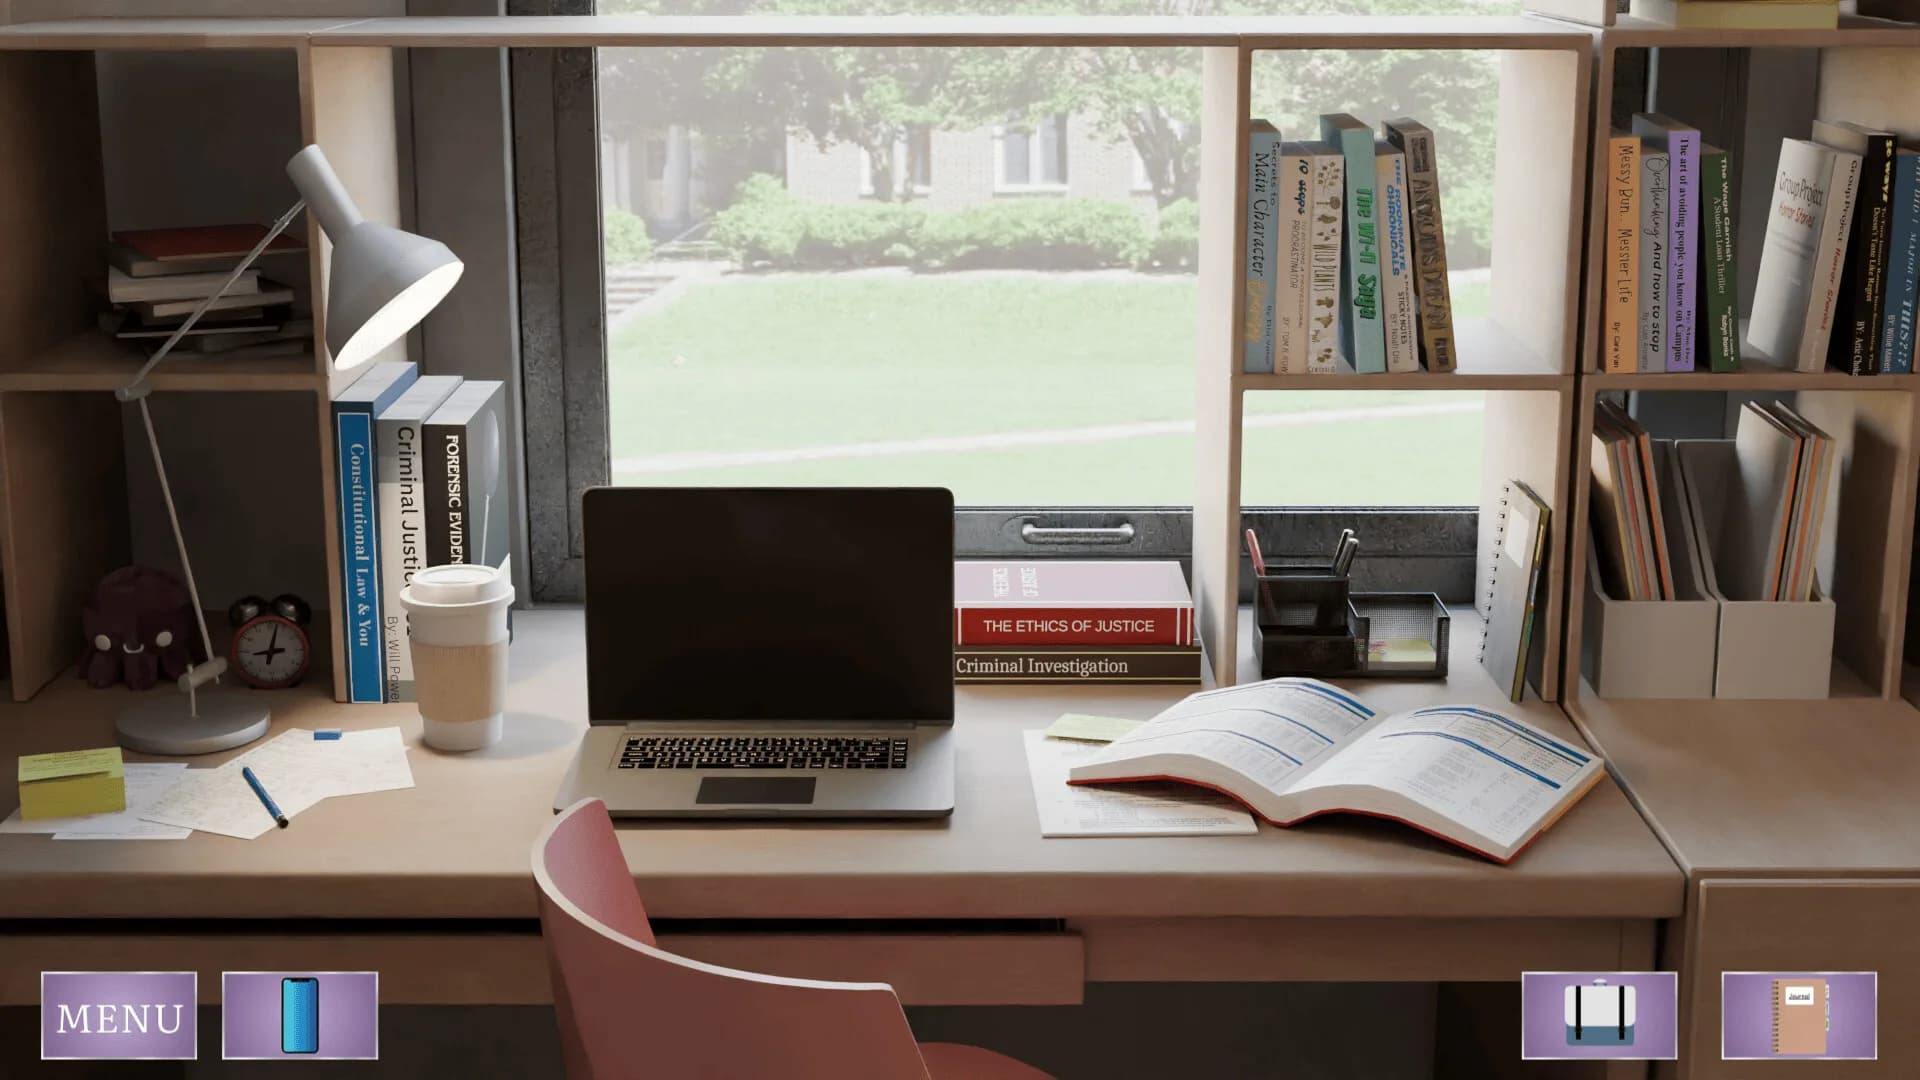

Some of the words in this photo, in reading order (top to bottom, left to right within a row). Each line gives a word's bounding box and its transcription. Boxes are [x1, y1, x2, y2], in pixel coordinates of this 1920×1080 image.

[1679, 137, 1689, 157] The
[1254, 153, 1271, 193] Main
[1271, 142, 1280, 188] Secrets
[1298, 159, 1310, 175] 10
[1616, 145, 1634, 185] Messy
[1679, 158, 1688, 173] art
[1720, 157, 1728, 179] The
[1845, 160, 1858, 199] Group
[1679, 175, 1688, 186] of
[1779, 171, 1801, 202] Group
[1799, 178, 1824, 207] Project
[1881, 161, 1892, 203] ways
[1270, 192, 1279, 206] to
[1293, 180, 1308, 216] steps
[1356, 187, 1374, 218] The
[1675, 187, 1688, 228] avoiding
[1711, 197, 1721, 205] A
[1721, 182, 1730, 214] Wage
[1912, 188, 1920, 213] DID
[1387, 185, 1401, 276] CHRONICALS
[1395, 189, 1407, 271] ROOMMATE
[1713, 205, 1723, 238] Student
[1837, 200, 1851, 242] Project
[1871, 207, 1881, 236] Doesn't
[1252, 199, 1271, 277] Character
[1312, 244, 1339, 262] WILD
[1618, 228, 1633, 275] Messier
[1674, 230, 1687, 261] people
[1715, 240, 1724, 261] Loan
[1723, 217, 1733, 262] Garnish
[1907, 231, 1917, 274] MAJOR
[1289, 219, 1301, 289] PROCRASTINATOR
[1652, 241, 1663, 270] And
[1829, 248, 1842, 284] Horror
[1867, 260, 1877, 277] Like
[1311, 265, 1338, 291] PLANTS
[1673, 263, 1685, 280] you
[1716, 263, 1726, 295] Thriller
[1904, 278, 1913, 292] IN
[1353, 273, 1377, 320] Saga
[1617, 279, 1632, 304] Life
[1652, 273, 1662, 301] how
[1676, 282, 1686, 307] know
[1864, 277, 1875, 302] Regret
[1398, 291, 1406, 317] STICKY
[1651, 305, 1661, 319] to
[1675, 310, 1683, 322] on
[1399, 319, 1408, 345] NOTES
[1649, 323, 1661, 353] stop
[1672, 324, 1684, 362] Campus
[397, 426, 419, 514] Criminal
[445, 434, 462, 508] FORENSIC
[349, 443, 370, 562] Constitutional
[402, 520, 419, 588] Justic
[355, 568, 370, 600] Law
[357, 602, 371, 617] &
[358, 620, 370, 647] You
[385, 616, 400, 635] By:
[983, 619, 1013, 632] THE
[1015, 619, 1069, 633] ETHICS
[1071, 619, 1092, 633] OF
[1094, 619, 1155, 633] JUSTICE
[388, 639, 401, 662] Will
[956, 657, 1024, 674] Criminal
[1027, 657, 1129, 677] Investigation
[388, 666, 401, 704] Power
